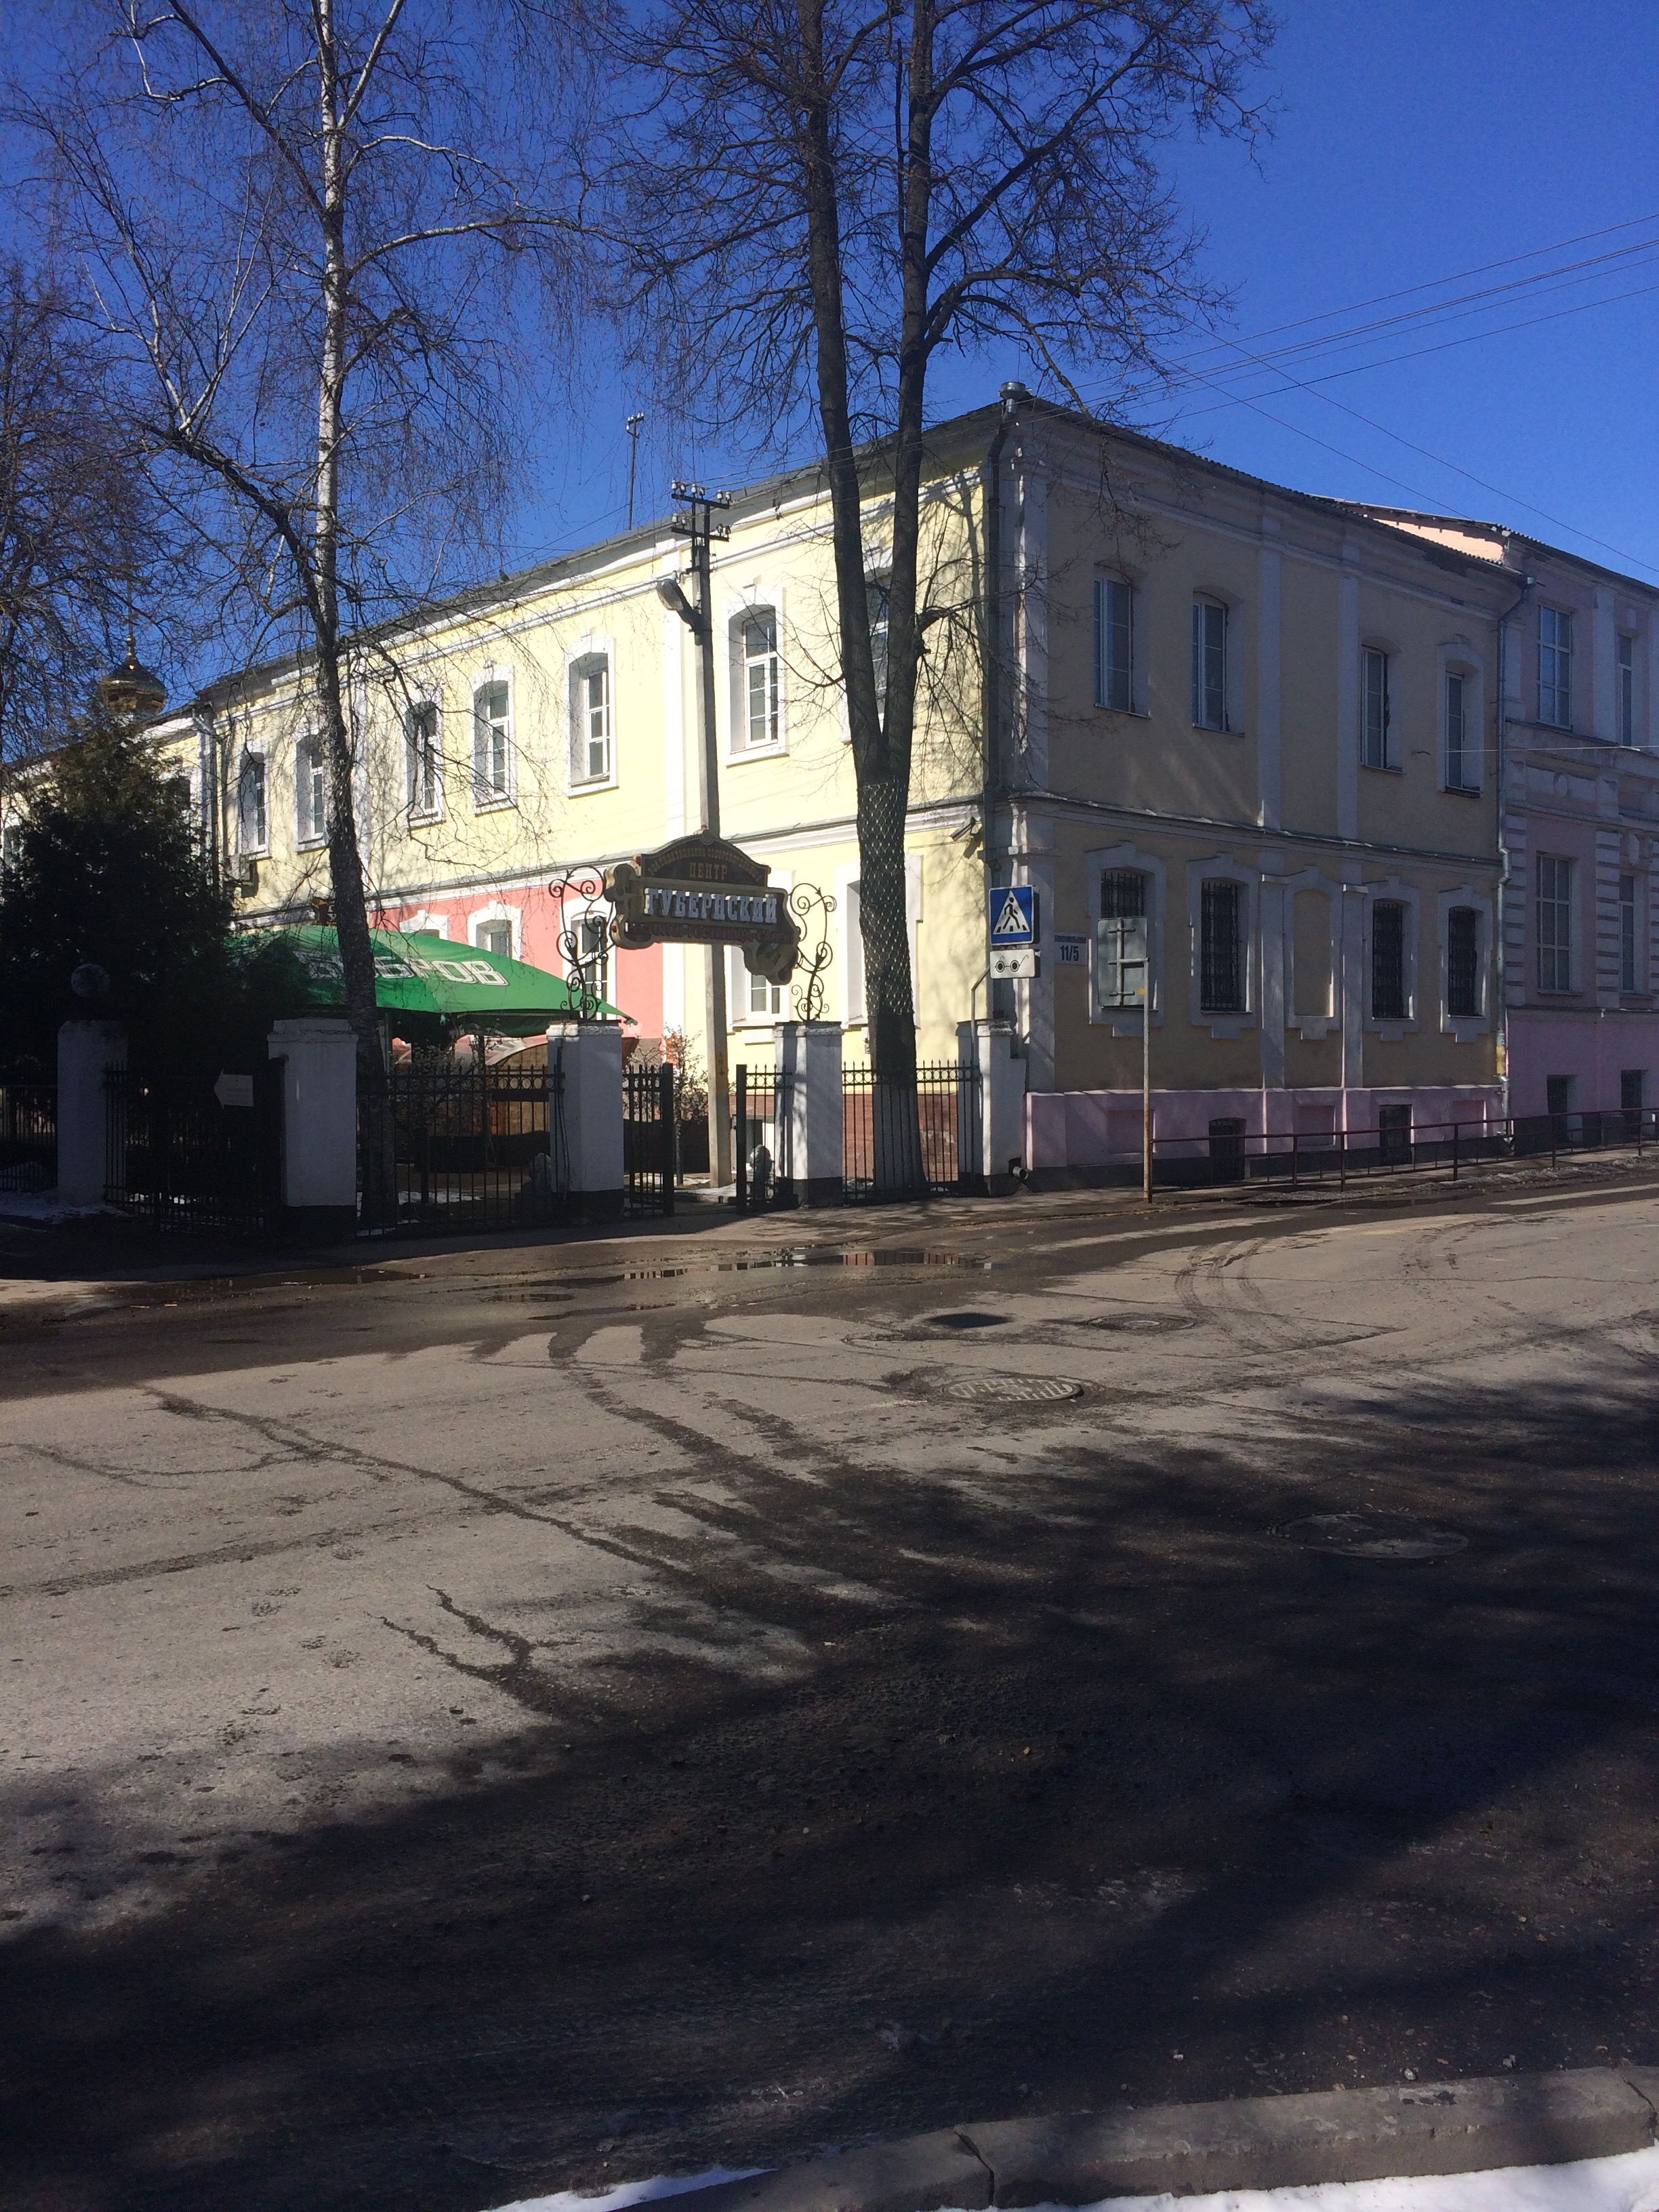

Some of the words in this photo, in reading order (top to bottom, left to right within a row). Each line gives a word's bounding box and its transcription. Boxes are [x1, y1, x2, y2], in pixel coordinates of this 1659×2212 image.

[689, 862, 728, 880] ЦЕНТР
[644, 888, 777, 924] ГУБЕРНСКИЙ
[1060, 945, 1079, 962] 11/5
[293, 951, 511, 987] ББРОВ
